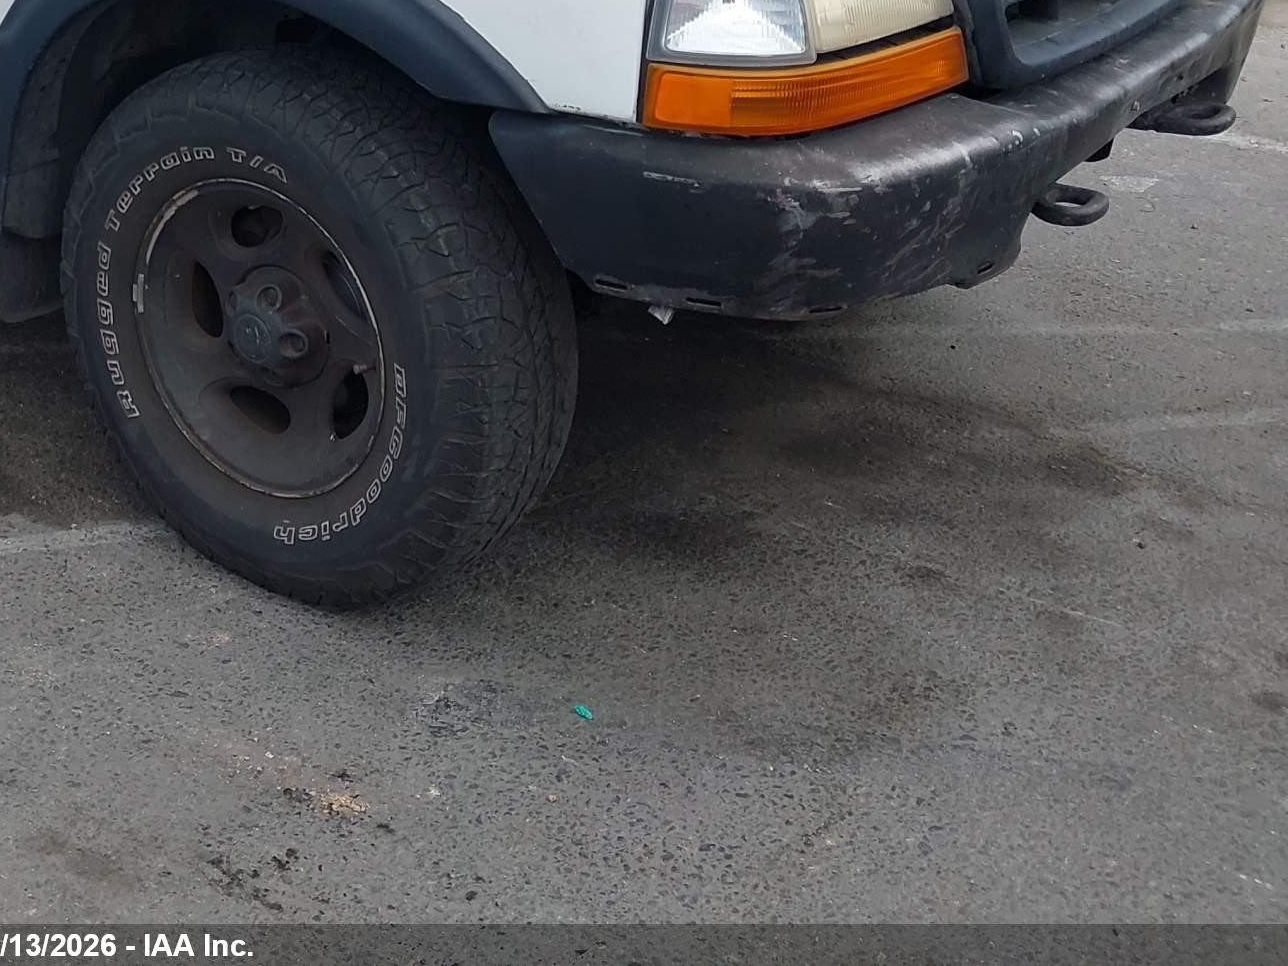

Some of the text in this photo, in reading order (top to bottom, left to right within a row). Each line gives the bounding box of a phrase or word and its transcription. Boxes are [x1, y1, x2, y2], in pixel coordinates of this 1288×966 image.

[95, 145, 289, 419] Rugged Terrain T/A
